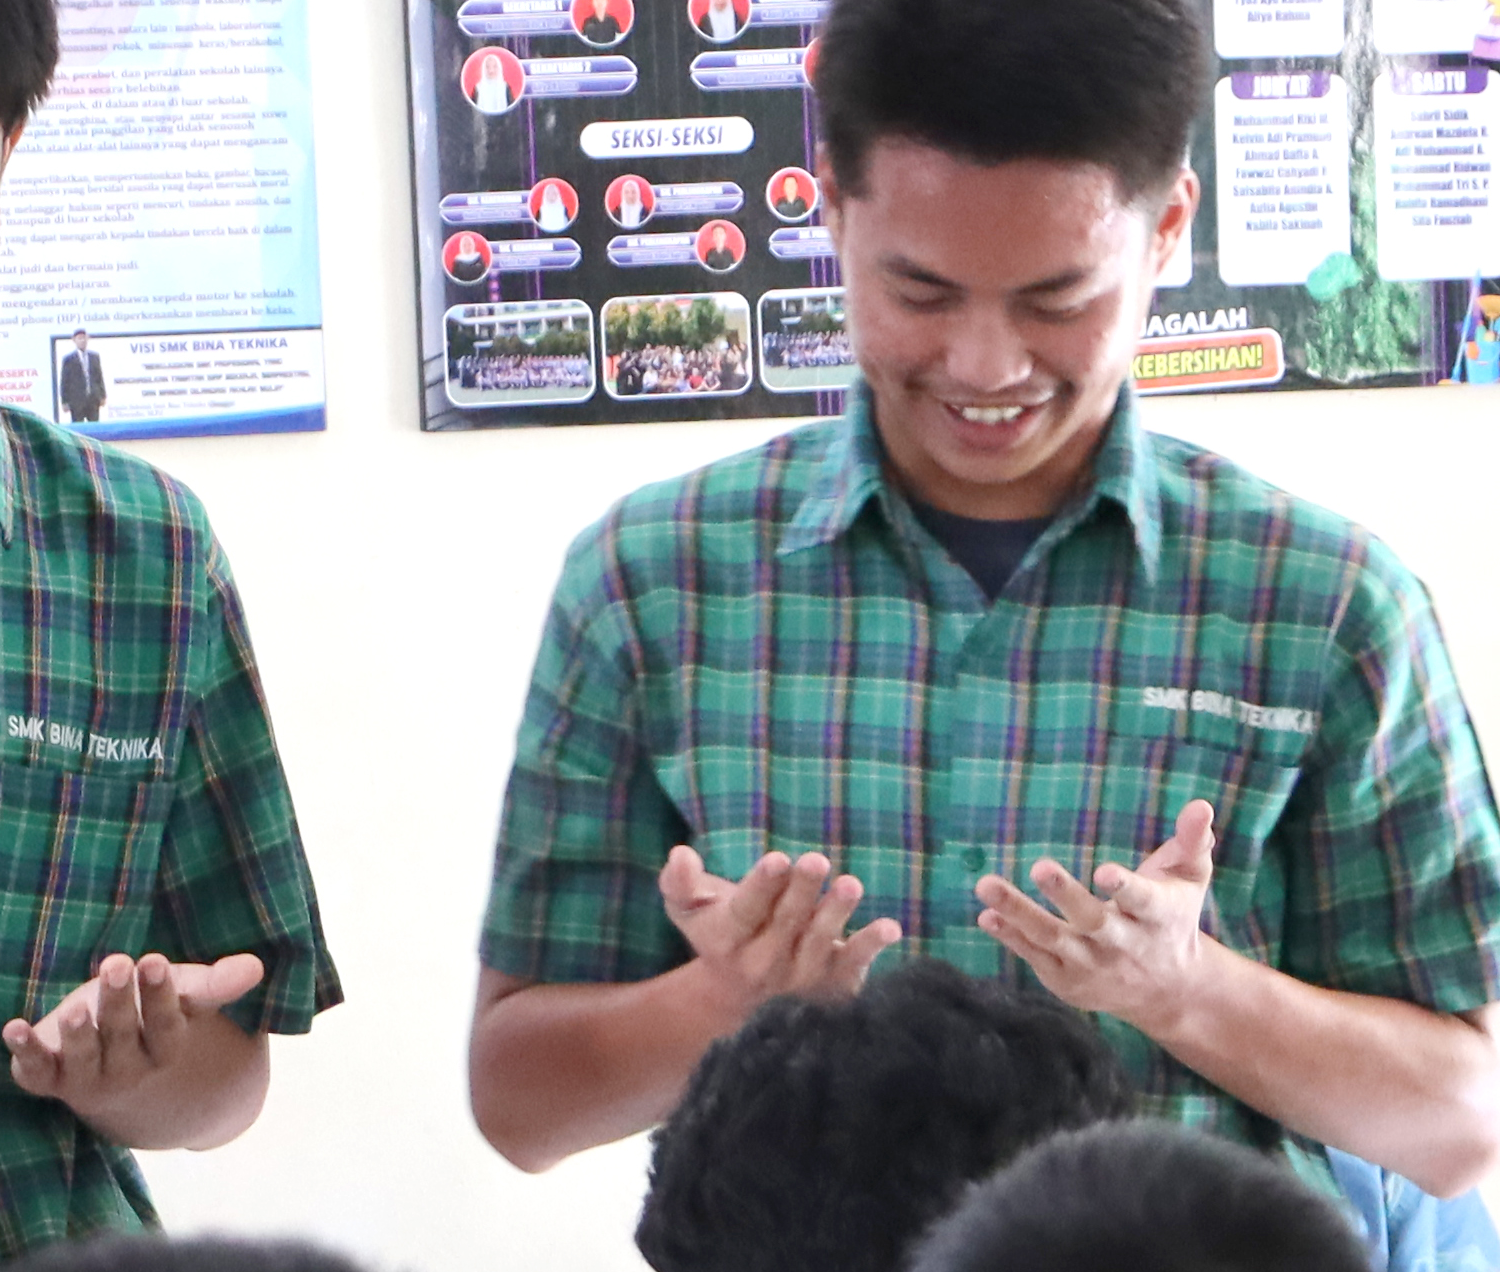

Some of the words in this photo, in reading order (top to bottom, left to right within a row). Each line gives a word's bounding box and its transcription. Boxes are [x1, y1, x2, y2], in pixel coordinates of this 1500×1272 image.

[1411, 71, 1466, 93] SABTU
[611, 125, 723, 148] SEKSI-SEKSI
[90, 293, 149, 306] membawa
[153, 292, 192, 306] sepeda
[234, 290, 247, 301] ke
[1139, 306, 1248, 337] JAGALAH
[130, 342, 156, 354] VISI
[159, 341, 190, 353] SMK
[193, 339, 226, 352] BINA
[230, 338, 288, 350] TEKNIKA
[1130, 343, 1263, 379] KEBERSIHAN!
[7, 715, 45, 742] SMK
[49, 722, 84, 753] BINA
[86, 733, 164, 761] TEKNIKA
